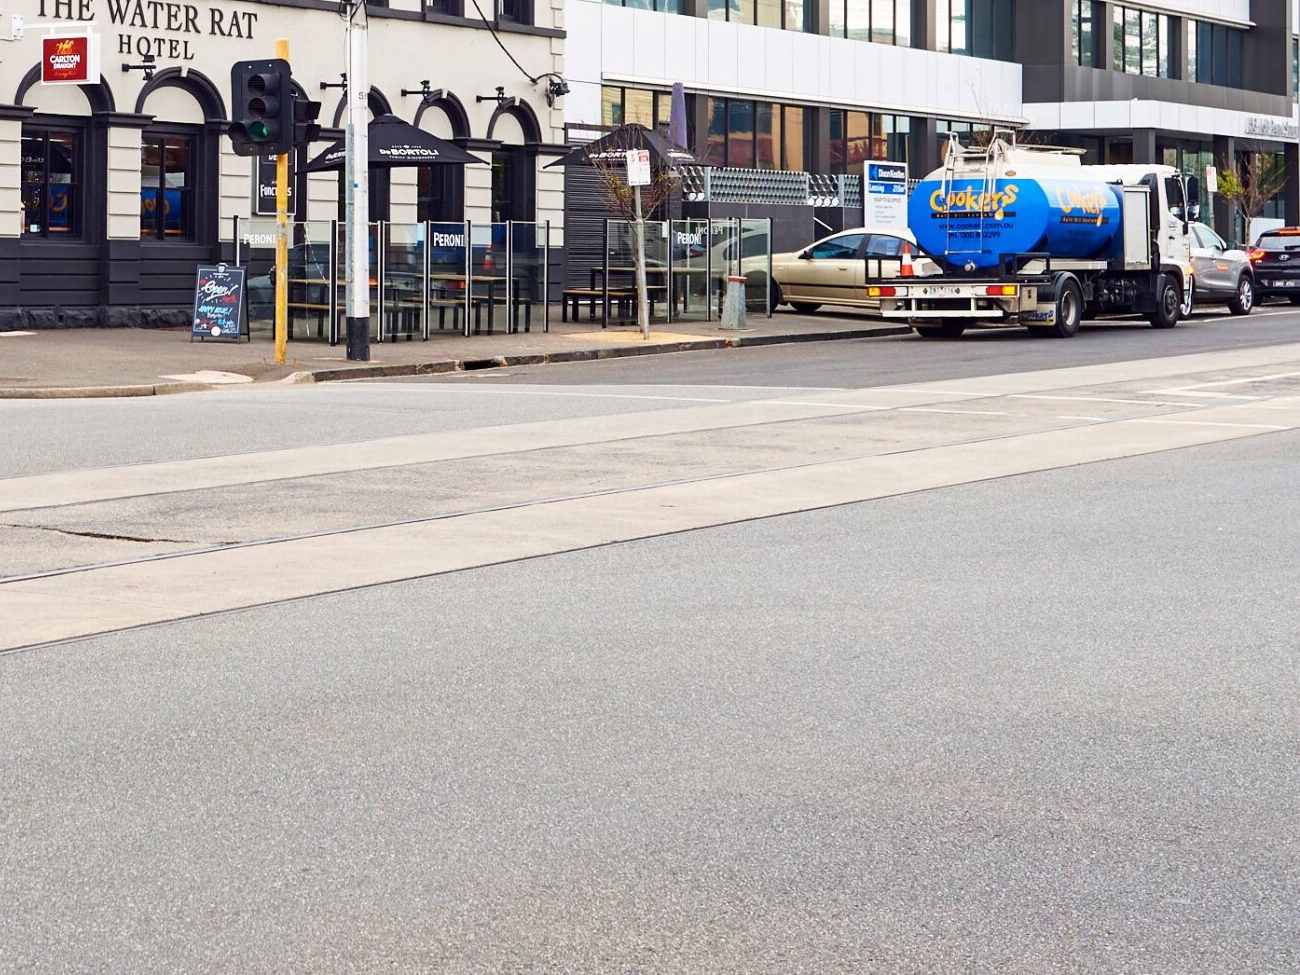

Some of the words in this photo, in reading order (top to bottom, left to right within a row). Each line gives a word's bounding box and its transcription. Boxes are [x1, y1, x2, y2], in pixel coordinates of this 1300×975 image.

[208, 7, 258, 39] RAT
[118, 34, 195, 60] HOTEL
[49, 54, 80, 64] CARLTON
[930, 184, 1019, 213] Cookers
[433, 231, 465, 247] PERONI
[677, 231, 703, 245] PERONI
